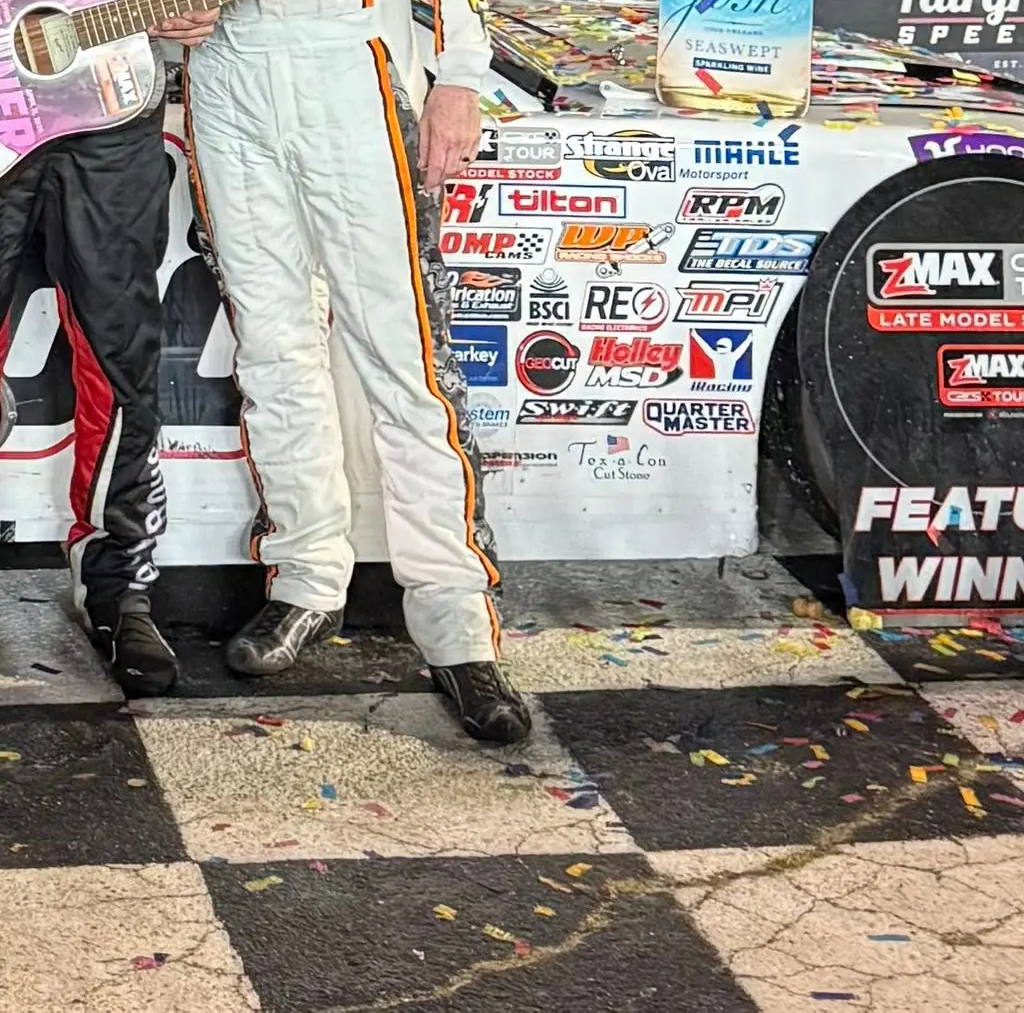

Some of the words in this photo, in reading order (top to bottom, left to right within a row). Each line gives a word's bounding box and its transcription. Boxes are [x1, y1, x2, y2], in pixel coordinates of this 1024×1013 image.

[685, 38, 782, 59] SEASWEPT
[503, 145, 556, 160] TOUR
[507, 169, 555, 180] STOCK
[627, 161, 675, 182] Oval
[679, 168, 749, 181] Motorsport
[508, 189, 618, 214] tilton
[689, 194, 781, 216] RPM
[440, 232, 517, 254] OMP
[712, 232, 817, 257] TDS
[485, 251, 533, 260] CAMS
[690, 258, 713, 268] THE
[715, 259, 753, 269] DECAL
[757, 259, 803, 270] SOURCE
[529, 301, 570, 320] BSCI
[880, 312, 932, 327] LATE
[940, 313, 1015, 327] MODEL
[526, 356, 579, 370] GEOCUT
[587, 336, 684, 371] Holley
[585, 366, 670, 388] MSD
[647, 402, 744, 423] QUARTER
[664, 417, 749, 432] MASTER
[593, 468, 616, 480] Cut
[855, 487, 1024, 531] FEAT
